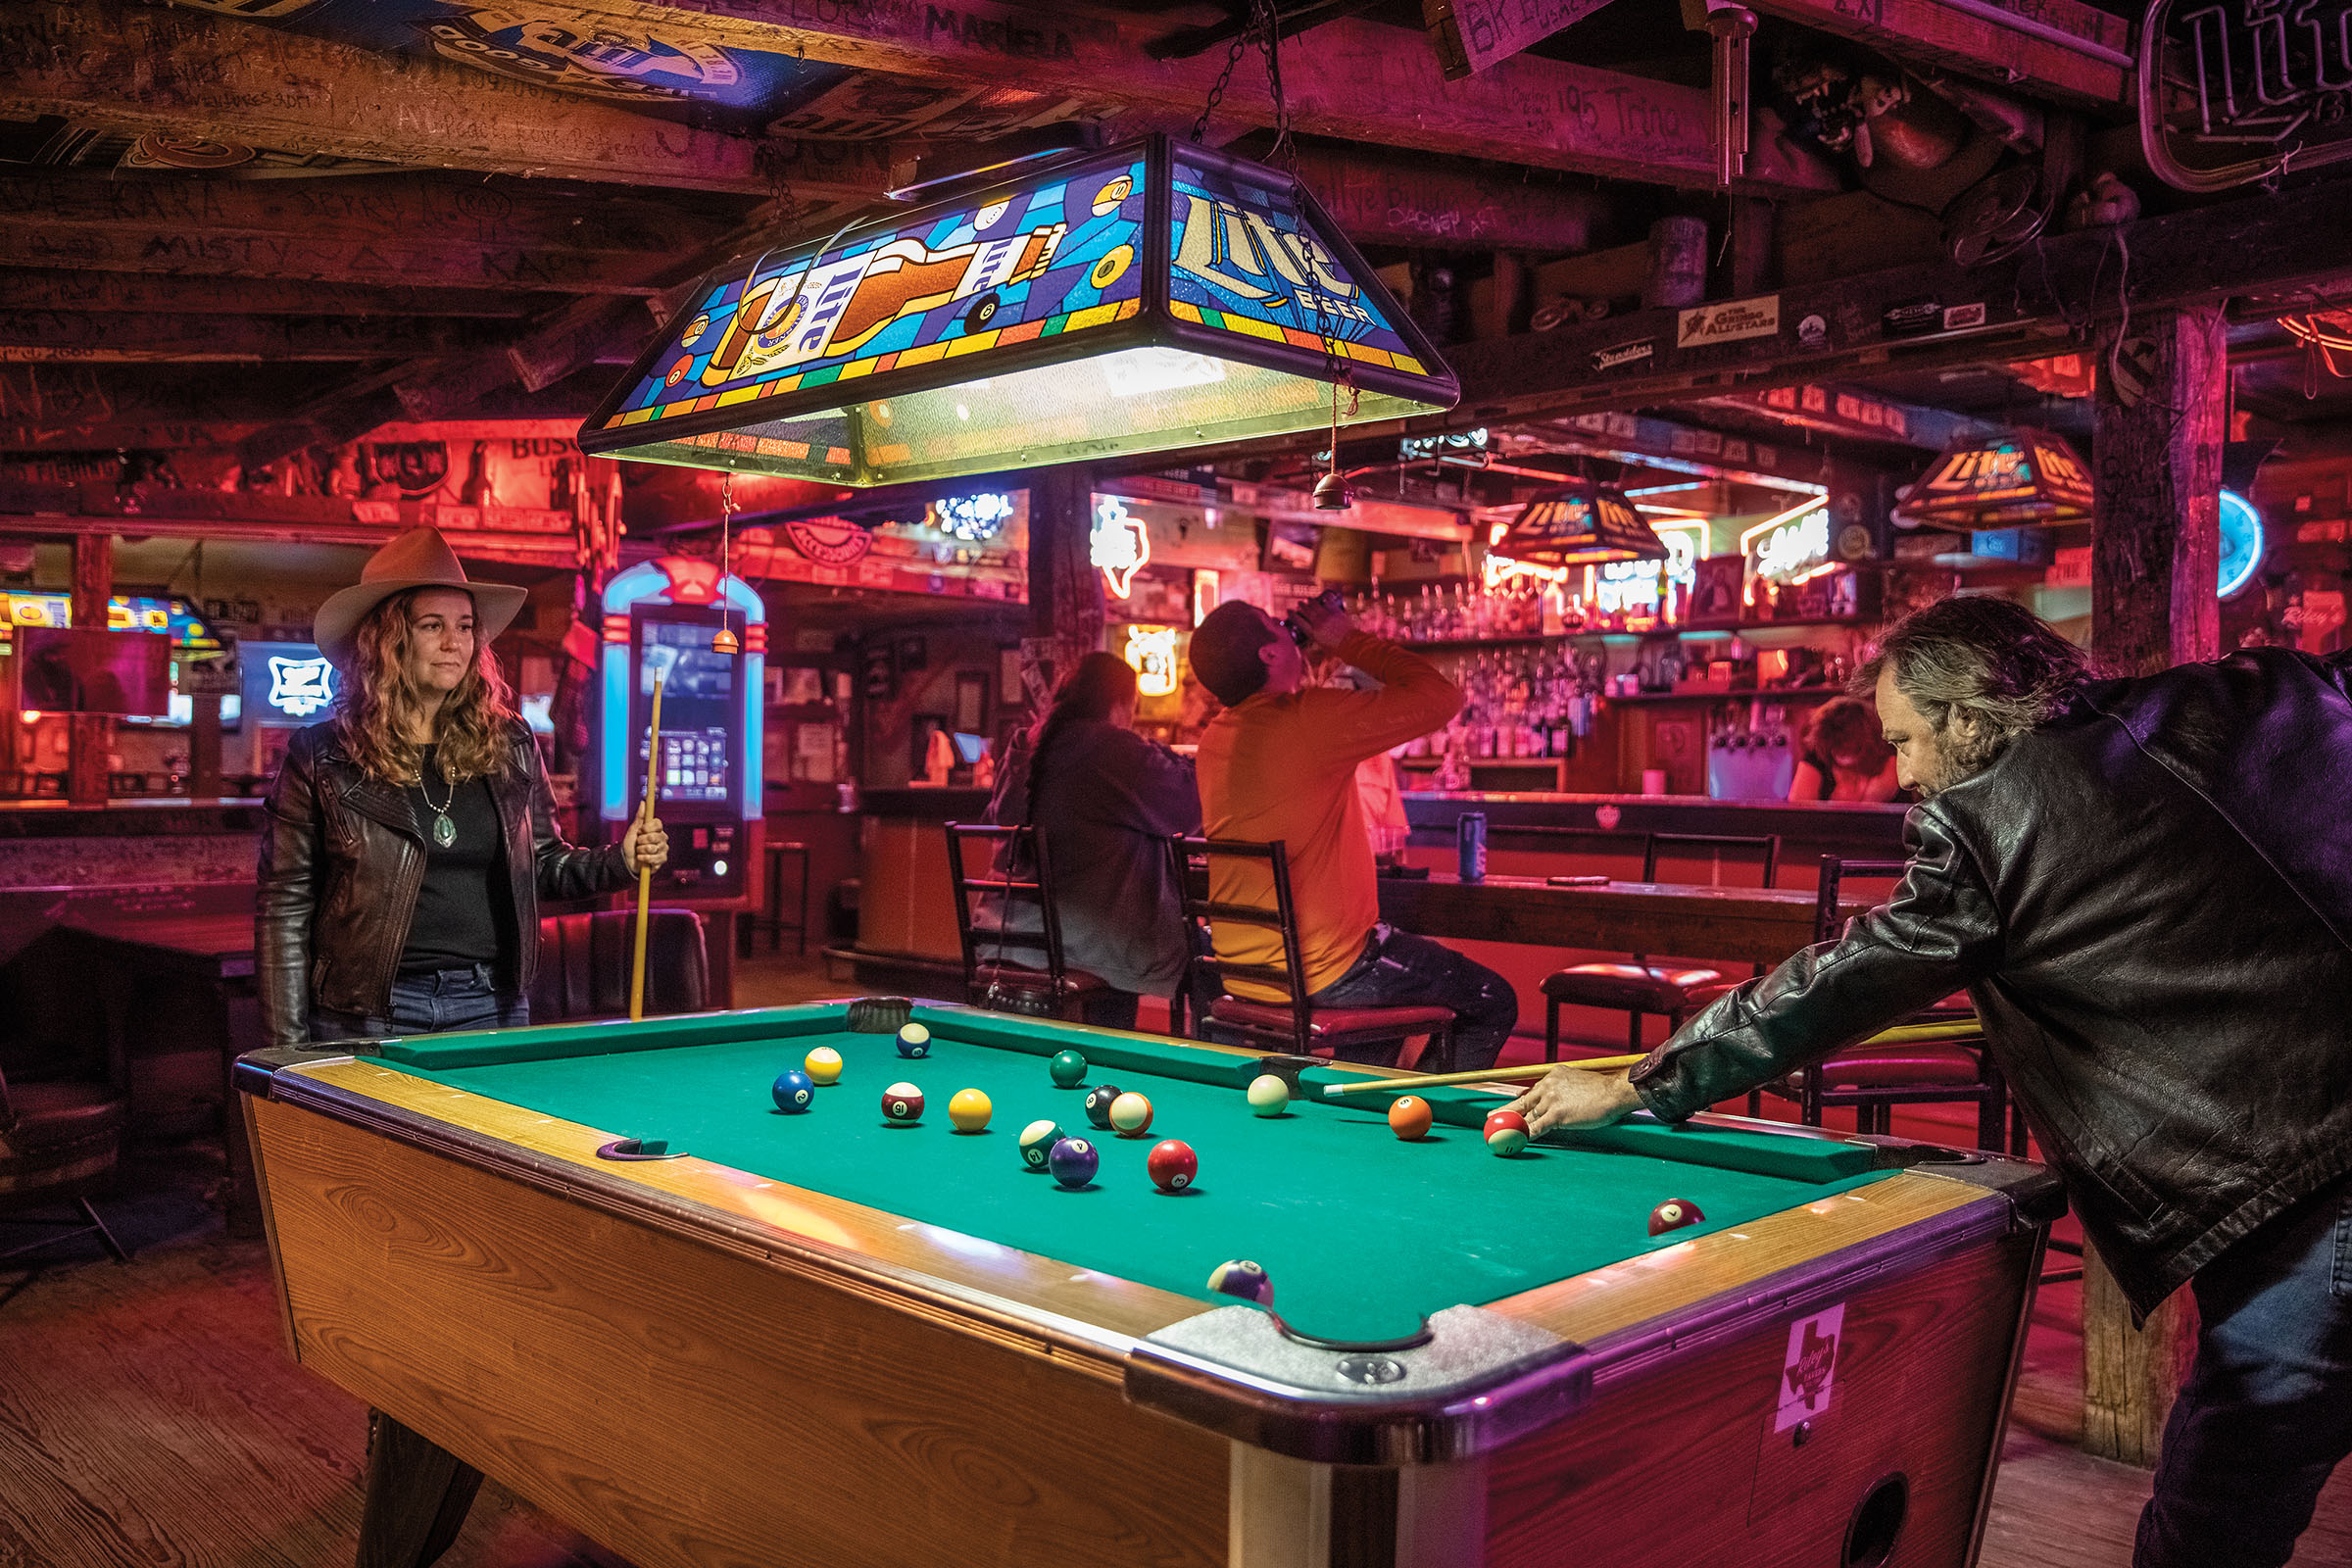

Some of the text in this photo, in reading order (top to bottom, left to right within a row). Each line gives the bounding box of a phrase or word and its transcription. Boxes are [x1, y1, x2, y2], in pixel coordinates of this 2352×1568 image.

[431, 25, 550, 71] GOOD
[1172, 195, 1354, 299] Lite
[1294, 289, 1377, 326] BEER
[895, 1103, 905, 1114] 15
[1029, 1152, 1041, 1162] 14
